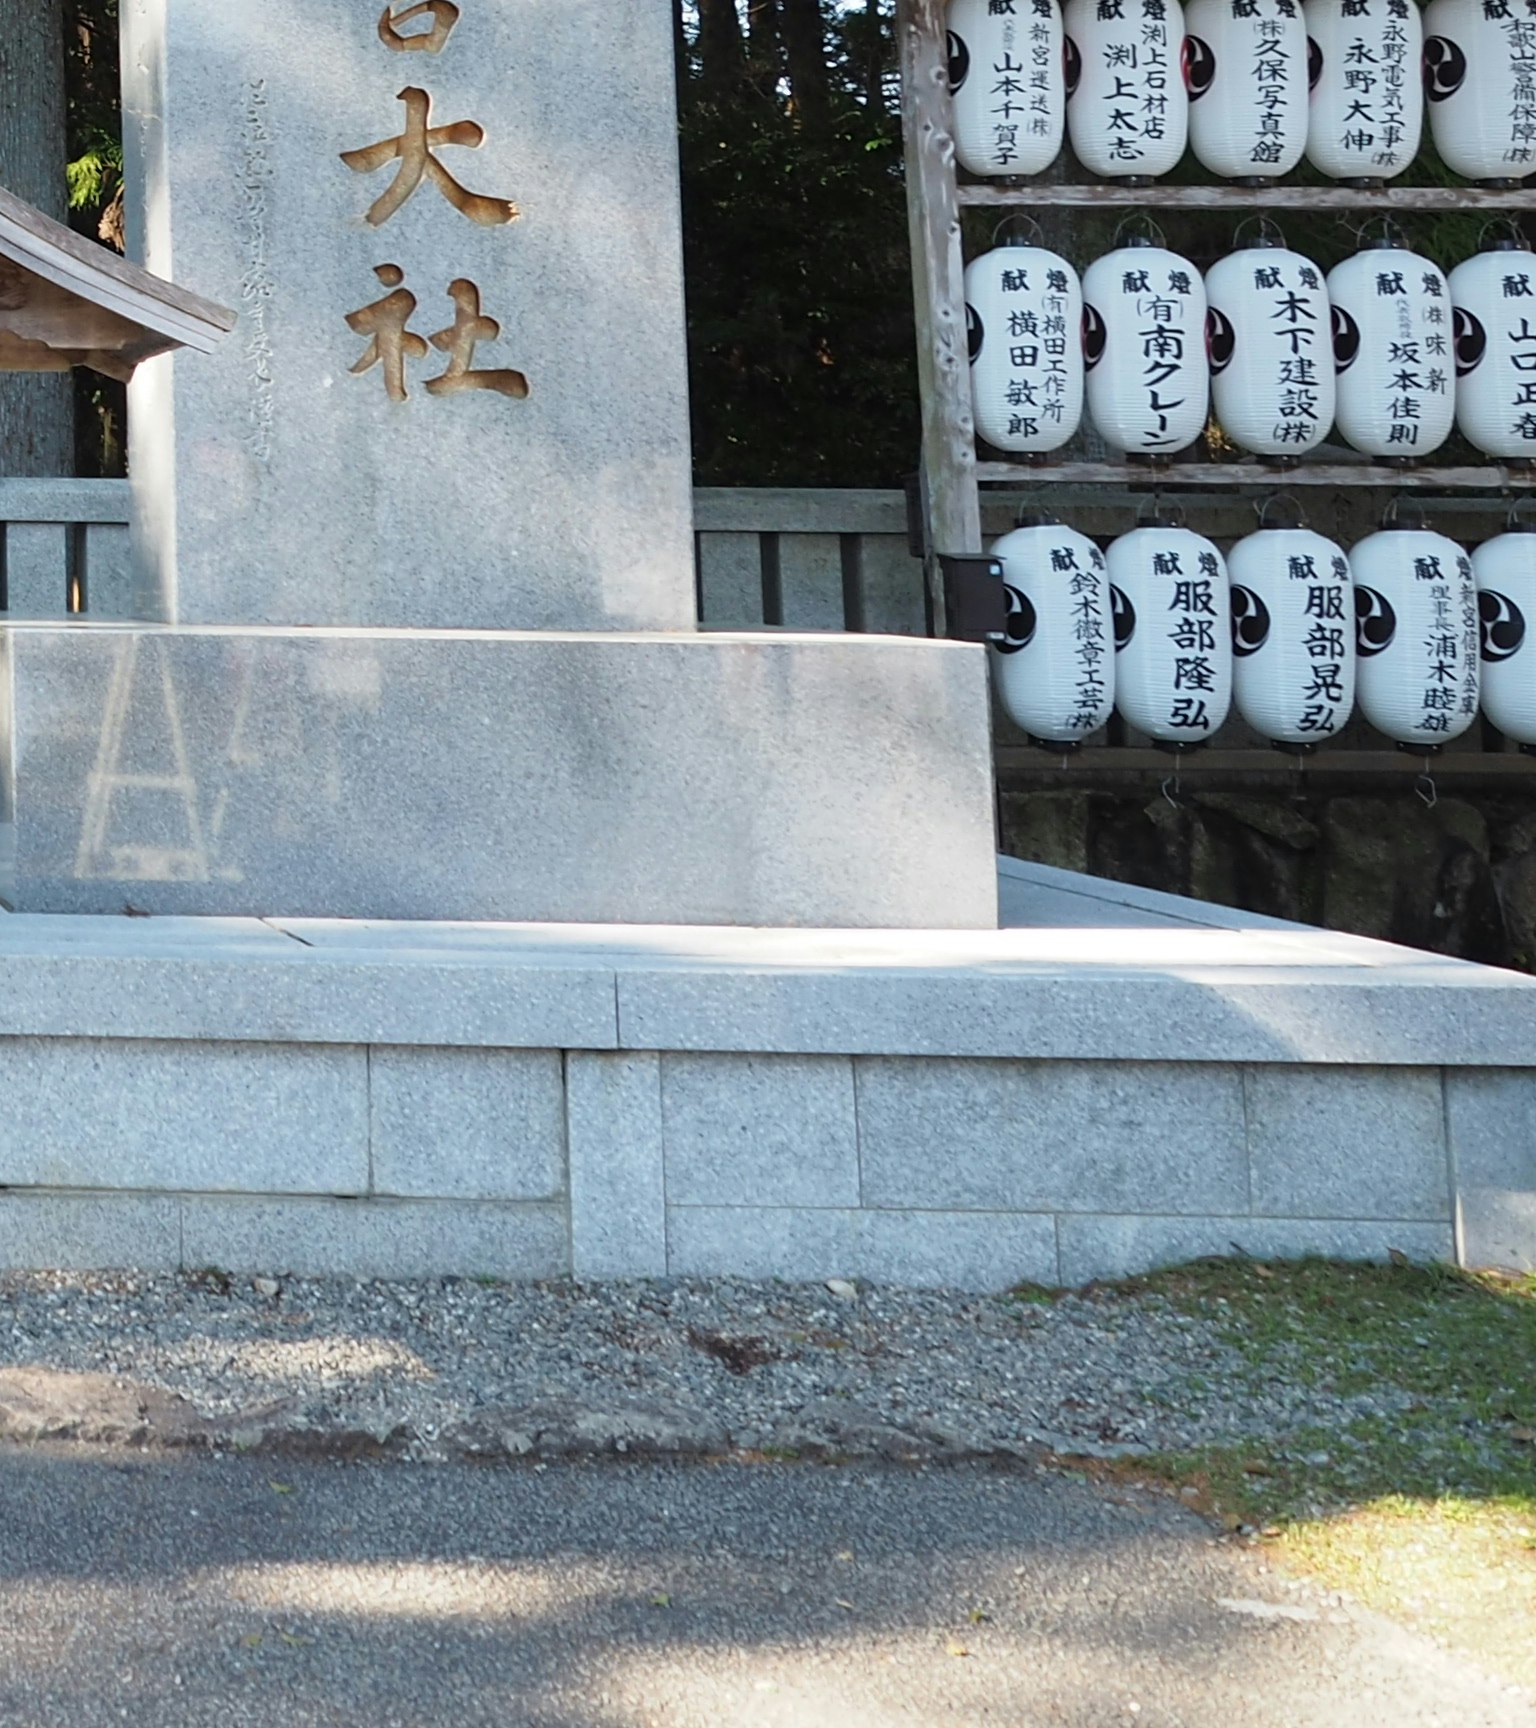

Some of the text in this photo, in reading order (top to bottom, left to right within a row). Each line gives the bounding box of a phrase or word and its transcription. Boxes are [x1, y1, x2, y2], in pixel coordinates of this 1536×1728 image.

[990, 53, 1027, 165] 山本千賀子
[1341, 37, 1379, 152] 永野大伸
[1005, 310, 1039, 437] 横田敏郎
[1136, 295, 1185, 447] (有)南クレーン
[1270, 291, 1320, 443] 木下建設(株)
[1385, 341, 1424, 445] 坂本佳則
[1168, 580, 1218, 731] 服部隆弘
[1296, 586, 1346, 734] 服部晃弘
